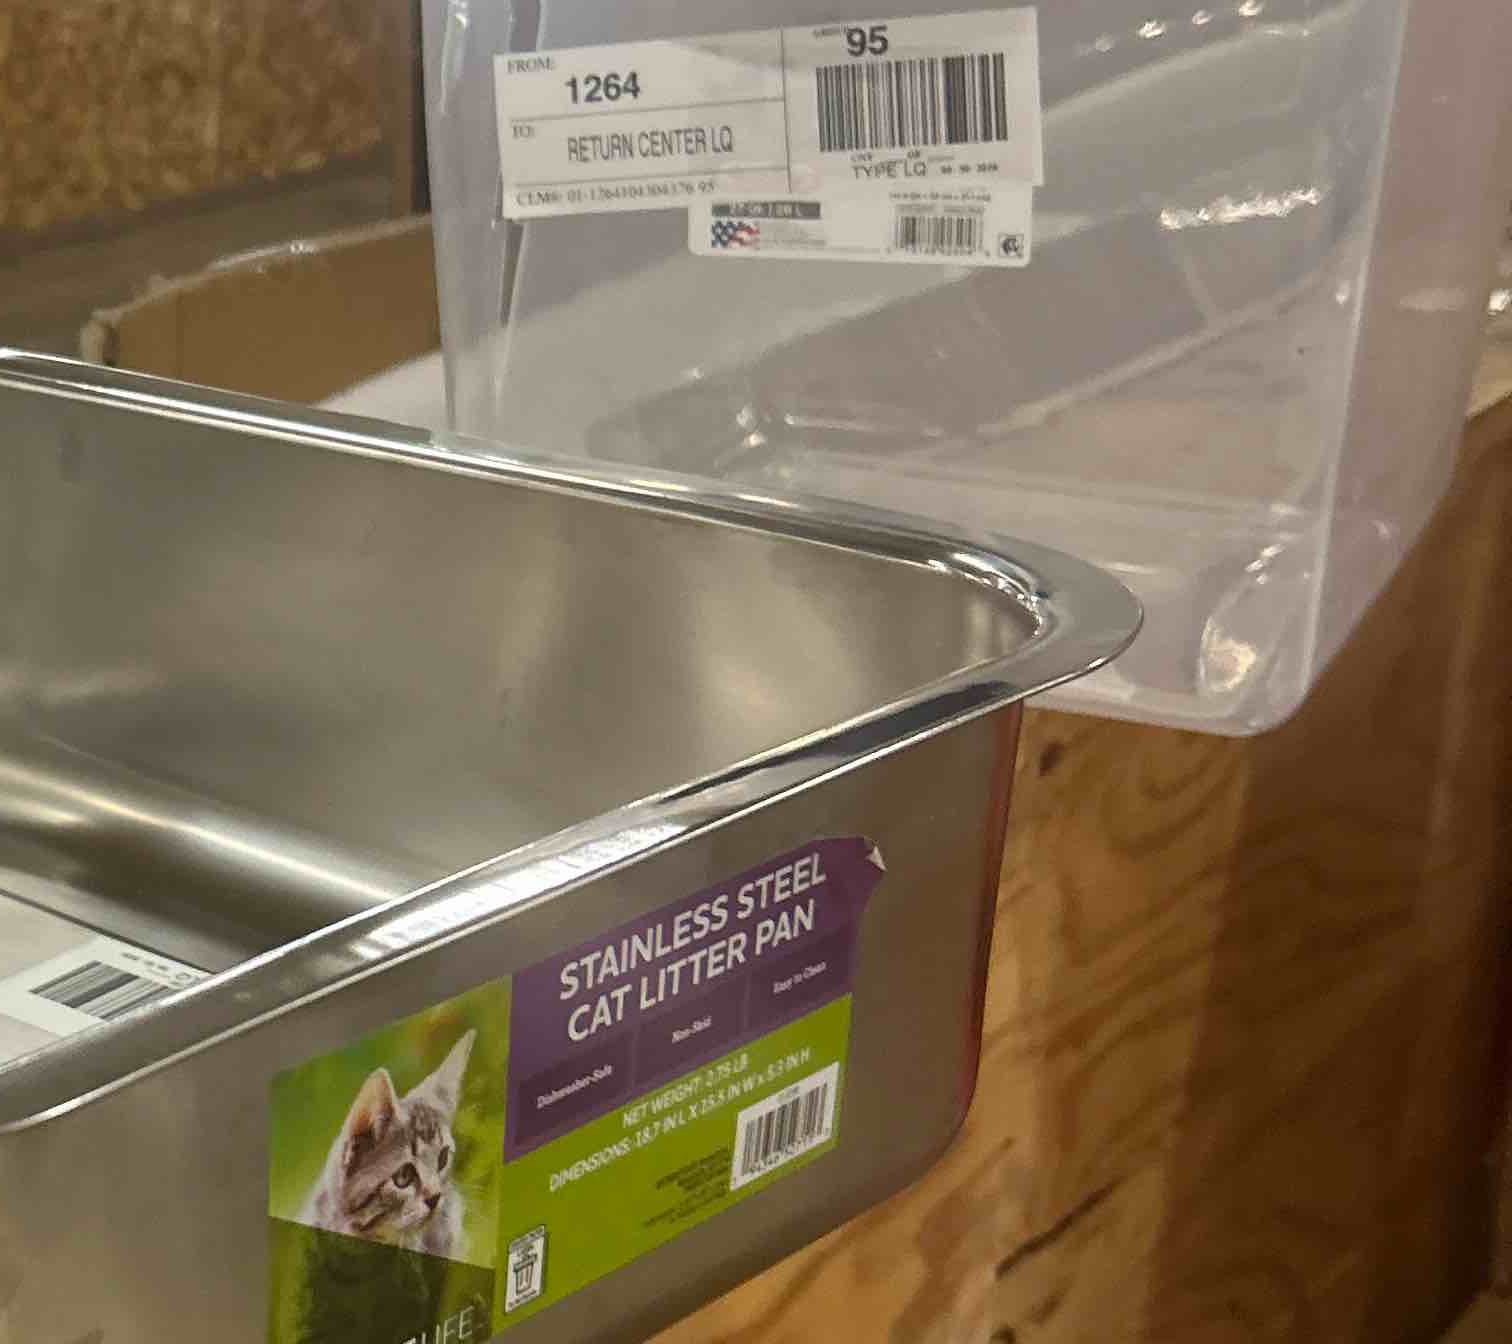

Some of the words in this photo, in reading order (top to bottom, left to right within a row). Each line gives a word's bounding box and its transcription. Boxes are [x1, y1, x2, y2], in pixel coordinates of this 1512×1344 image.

[845, 24, 889, 56] 95
[506, 57, 555, 74] FROM:
[565, 71, 640, 104] 1264
[567, 132, 633, 162] RETURN
[637, 128, 706, 158] CENTER
[711, 125, 734, 153] LQ
[852, 161, 898, 179] TYPE
[904, 160, 927, 177] LQ
[559, 894, 729, 1000] STAINLESS
[737, 852, 827, 920] STEEL
[567, 983, 633, 1041] CAT
[640, 931, 747, 1010] LITTER
[754, 898, 816, 956] PAN
[623, 1103, 649, 1128] NET
